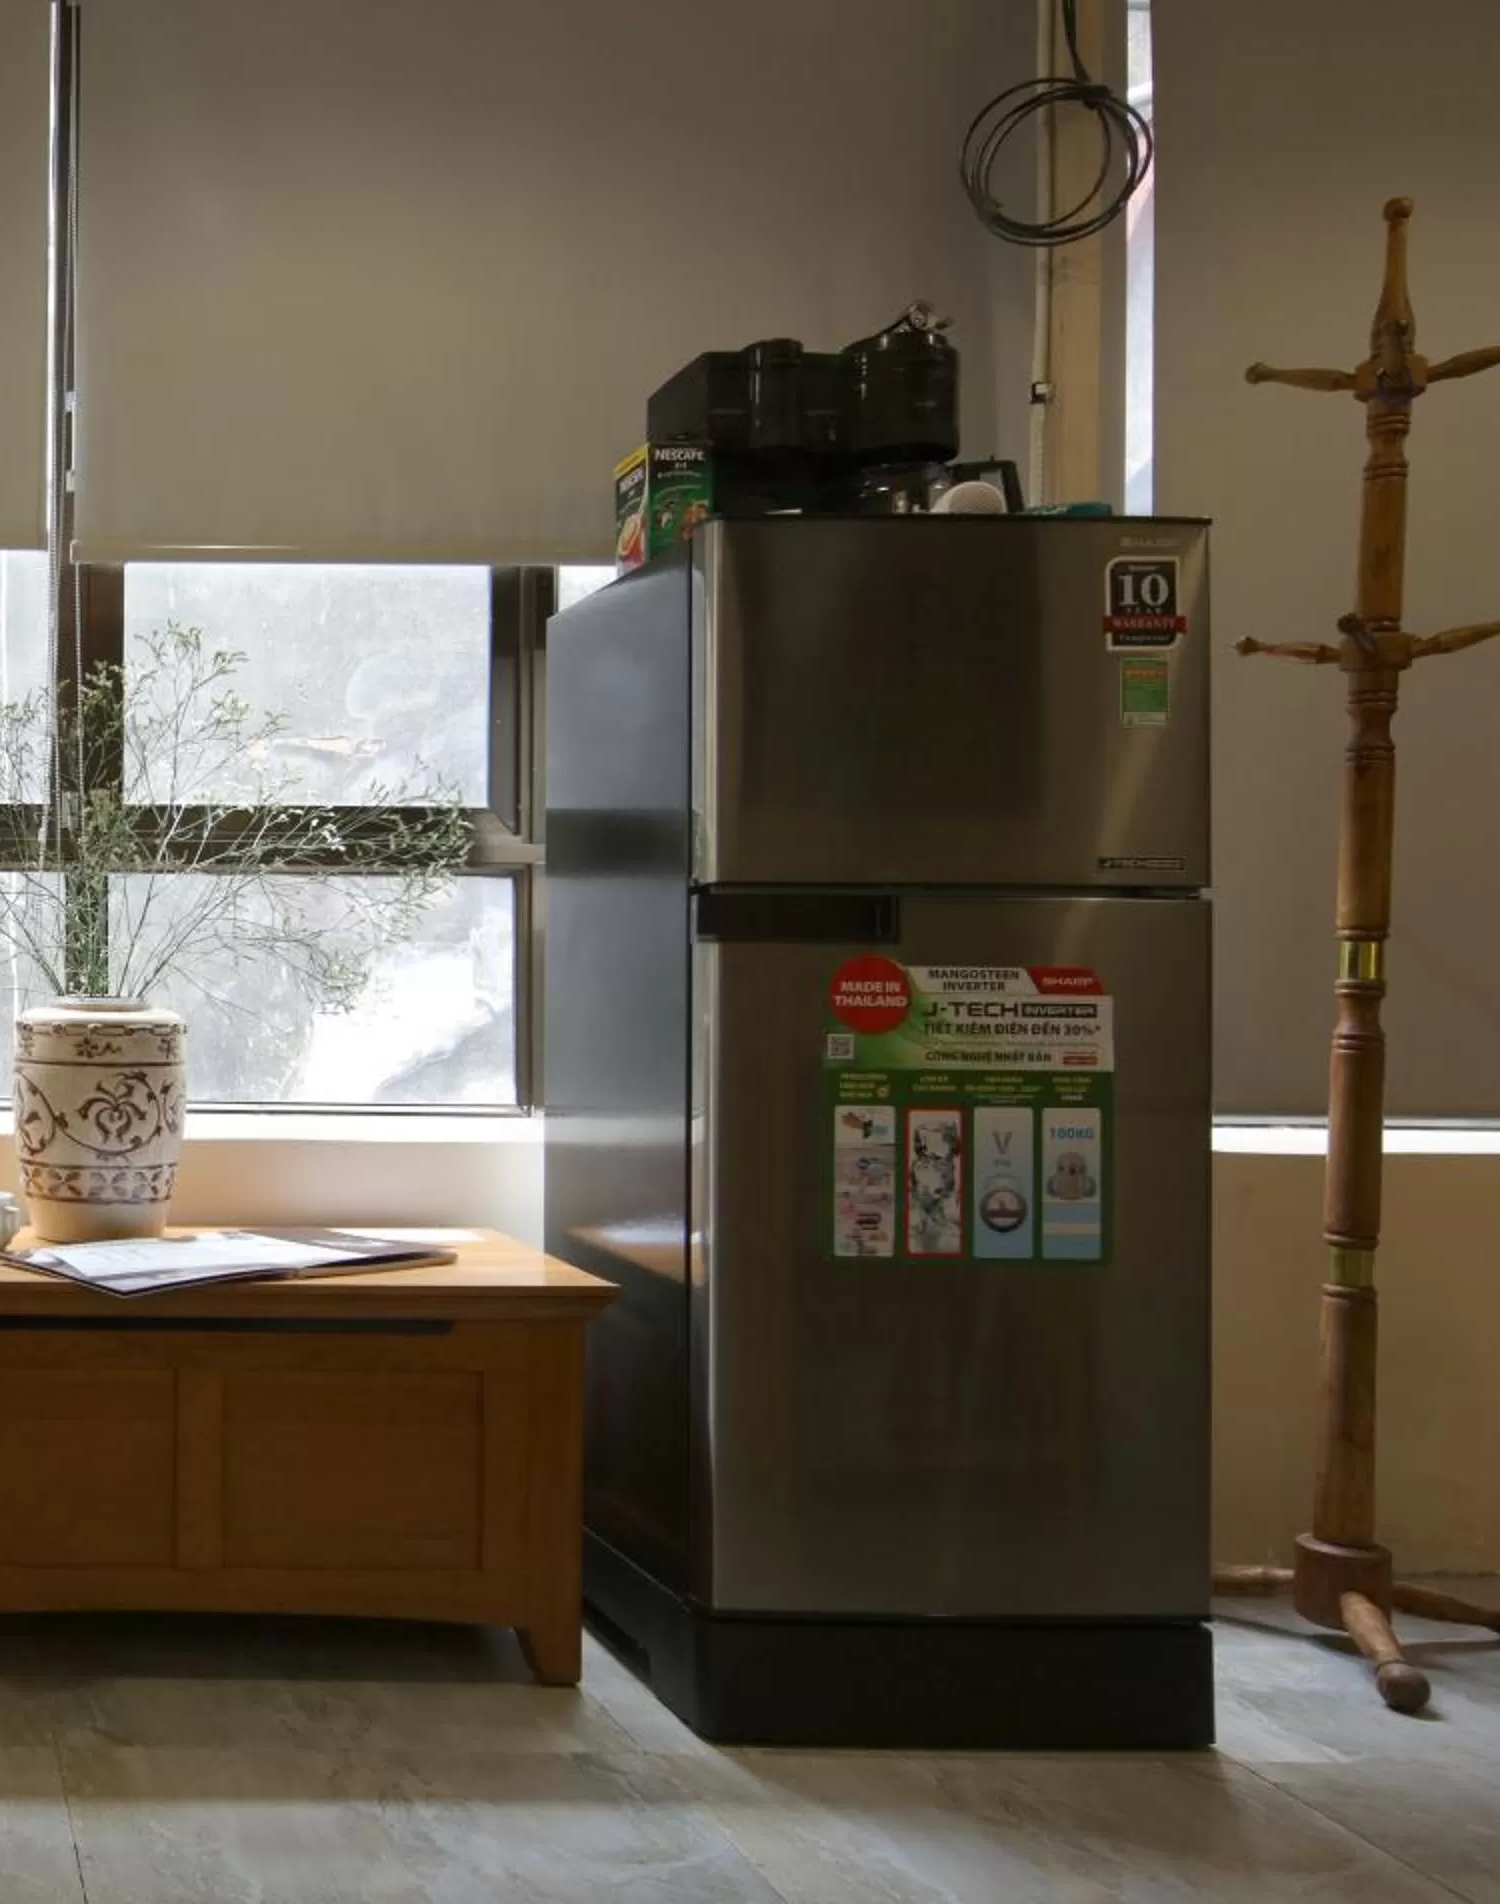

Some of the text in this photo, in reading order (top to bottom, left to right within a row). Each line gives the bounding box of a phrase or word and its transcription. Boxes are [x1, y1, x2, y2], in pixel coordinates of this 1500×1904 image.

[1118, 573, 1169, 607] 10
[927, 968, 1020, 980] MANGOSTEEN
[840, 980, 901, 993] MADE IN
[942, 981, 1005, 991] INVERTER
[1043, 976, 1093, 988] SHARP
[834, 994, 909, 1008] THAILAND
[922, 1001, 1019, 1017] J-TECH
